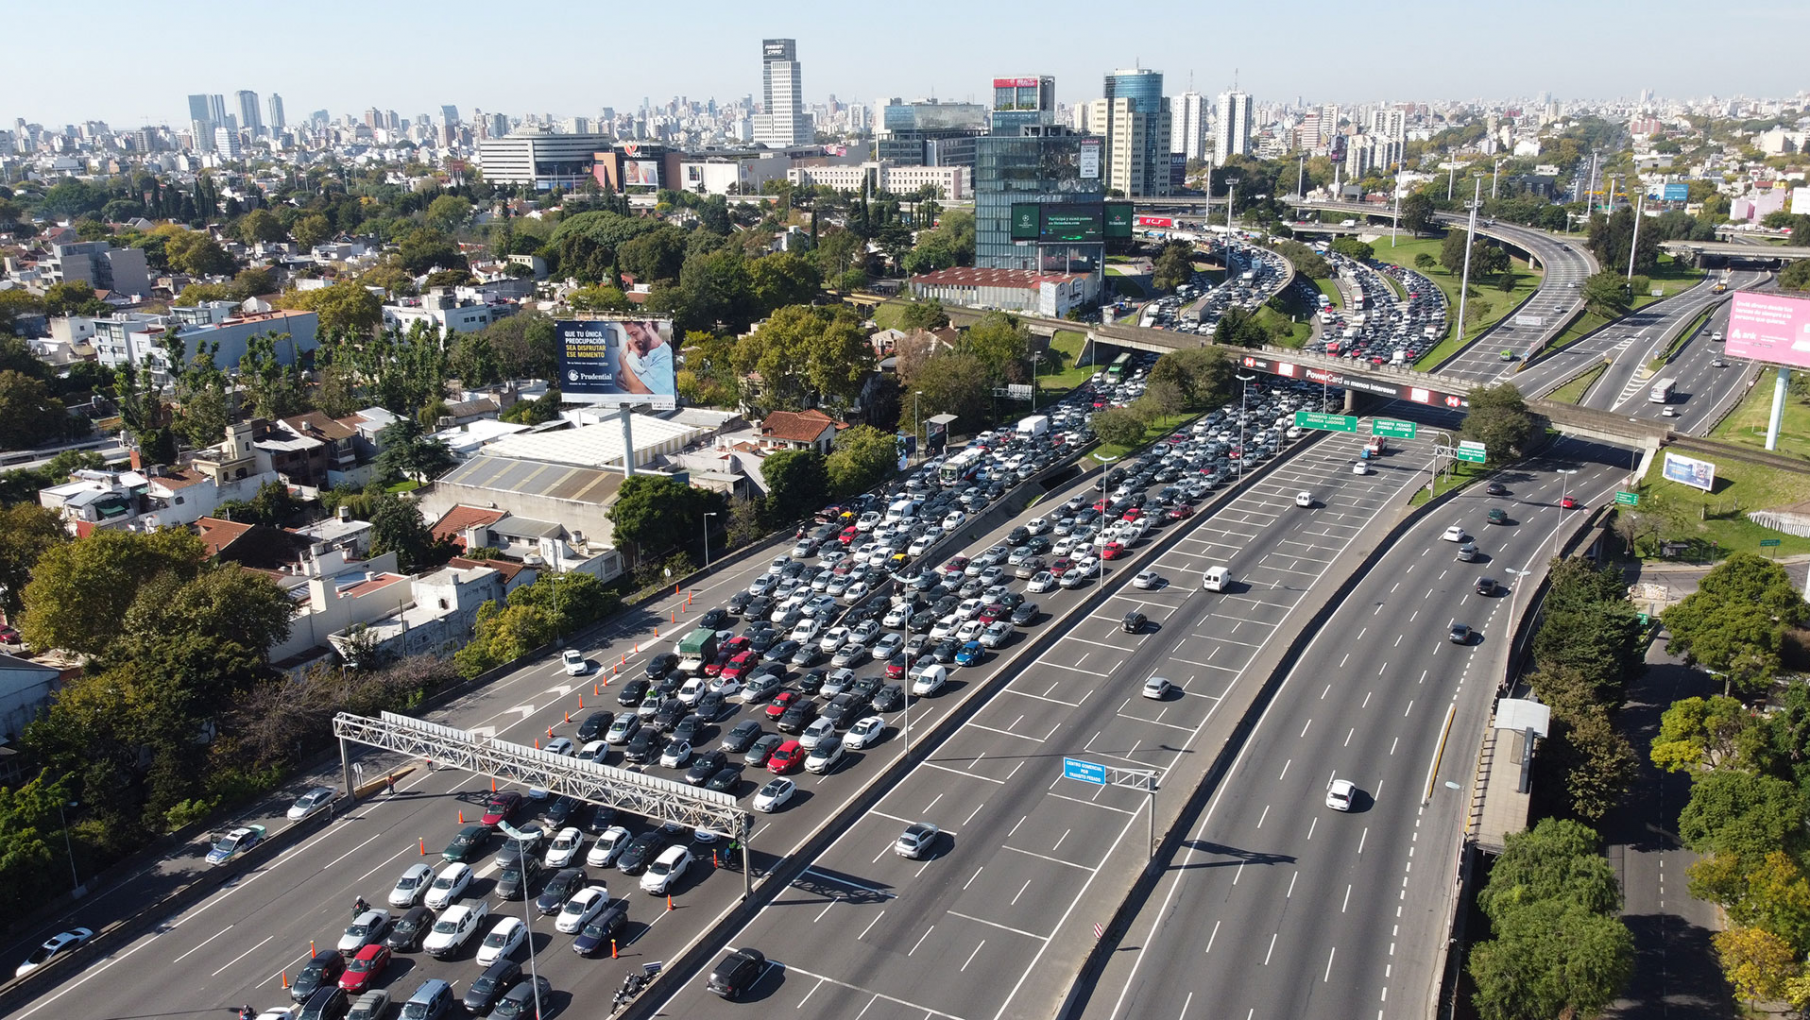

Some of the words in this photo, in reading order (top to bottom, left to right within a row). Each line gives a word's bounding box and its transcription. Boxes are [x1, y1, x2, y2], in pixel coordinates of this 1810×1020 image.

[1742, 332, 1757, 340] ank
[1306, 370, 1343, 384] PowerCard
[1370, 384, 1396, 394] intereses
[1082, 764, 1102, 772] COMERCIAL
